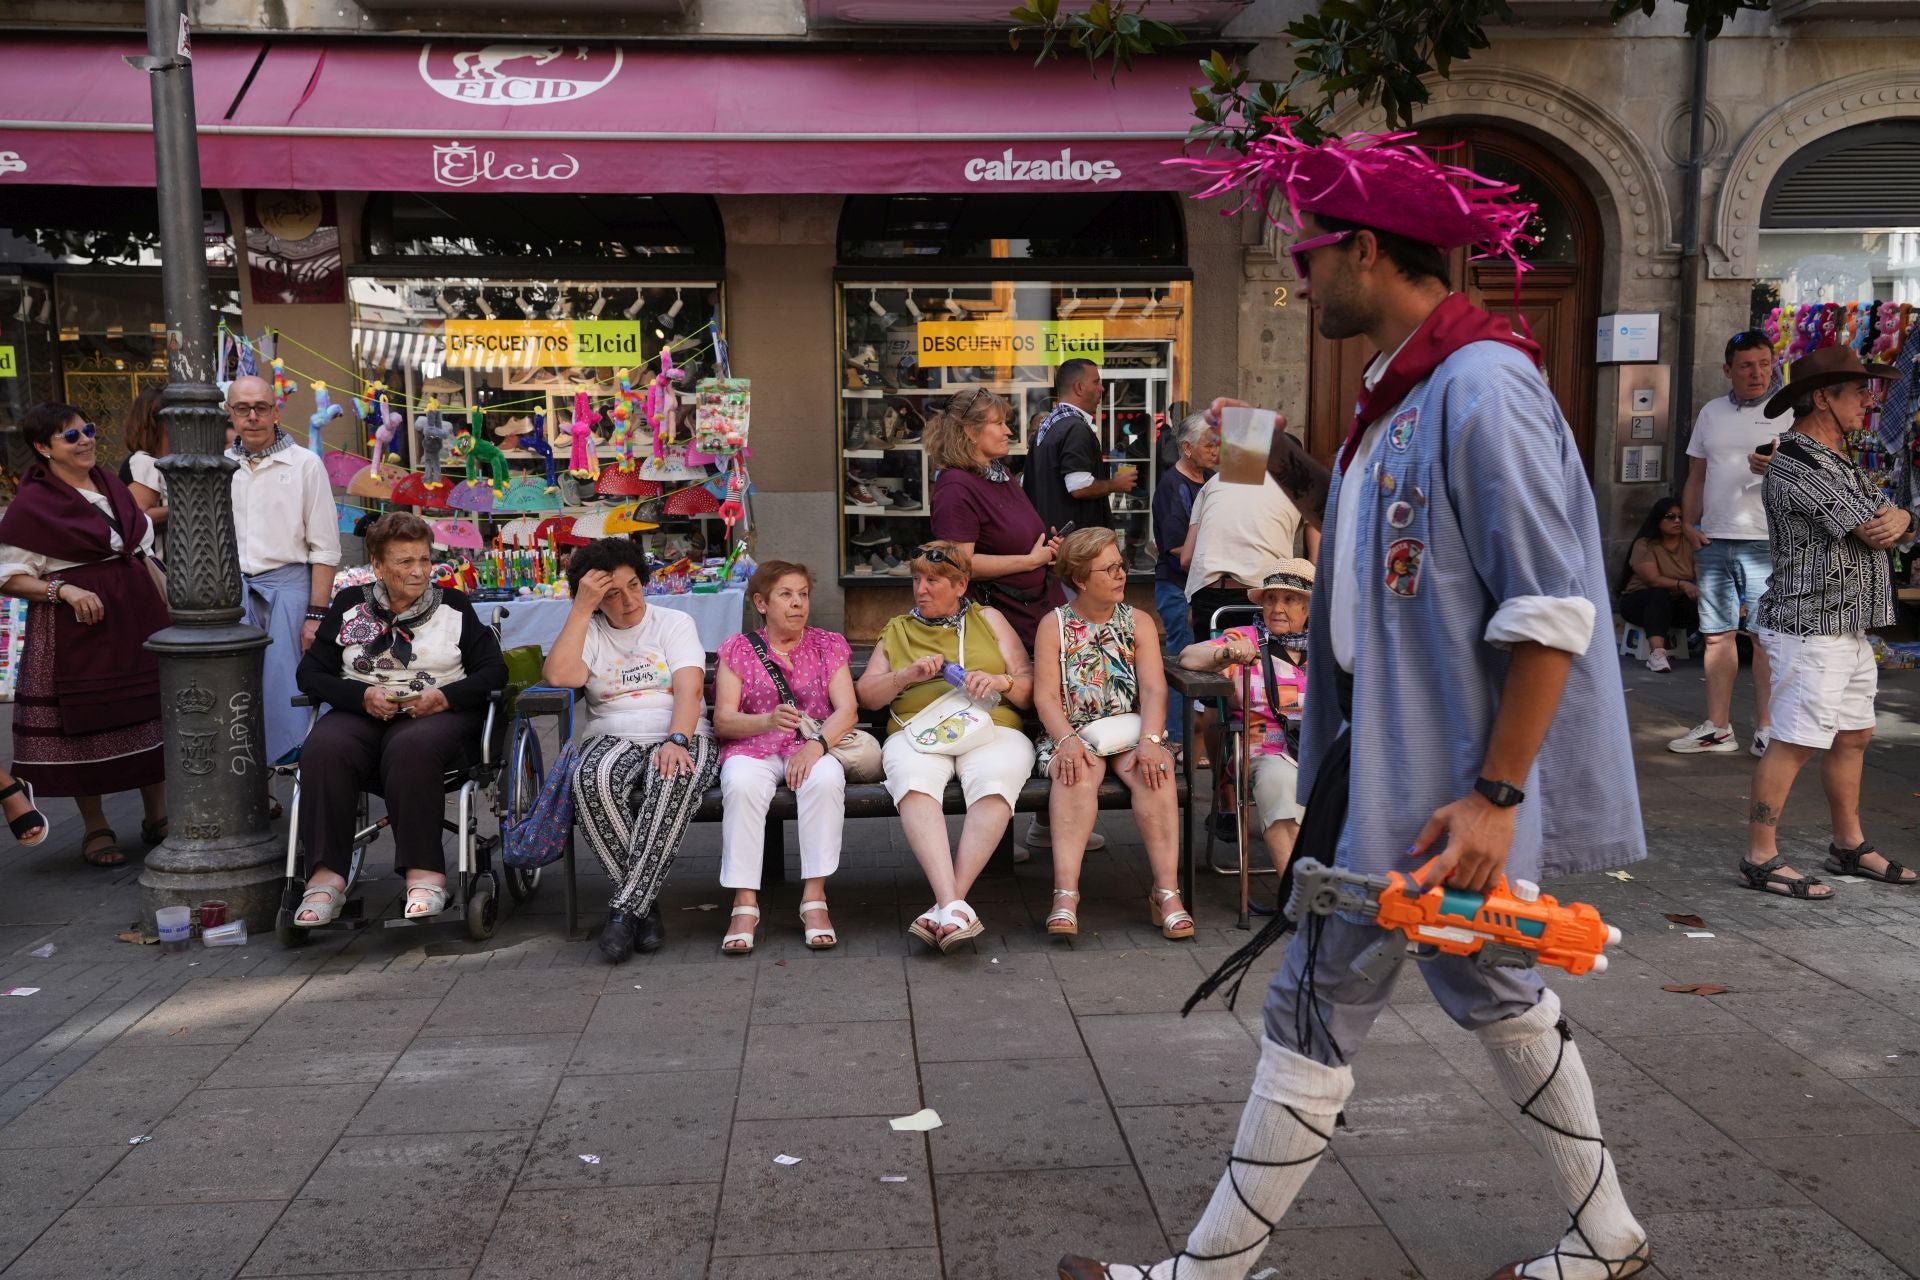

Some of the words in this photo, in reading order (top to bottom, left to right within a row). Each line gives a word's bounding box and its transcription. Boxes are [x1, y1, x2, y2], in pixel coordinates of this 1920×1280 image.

[455, 79, 578, 99] ELCID
[437, 147, 580, 182] Elcid
[964, 147, 1122, 185] calzados
[1274, 286, 1288, 307] 2
[450, 334, 569, 352] DESCUENTOS
[578, 332, 637, 353] Elcid
[922, 335, 1035, 352] DESCUENTOS
